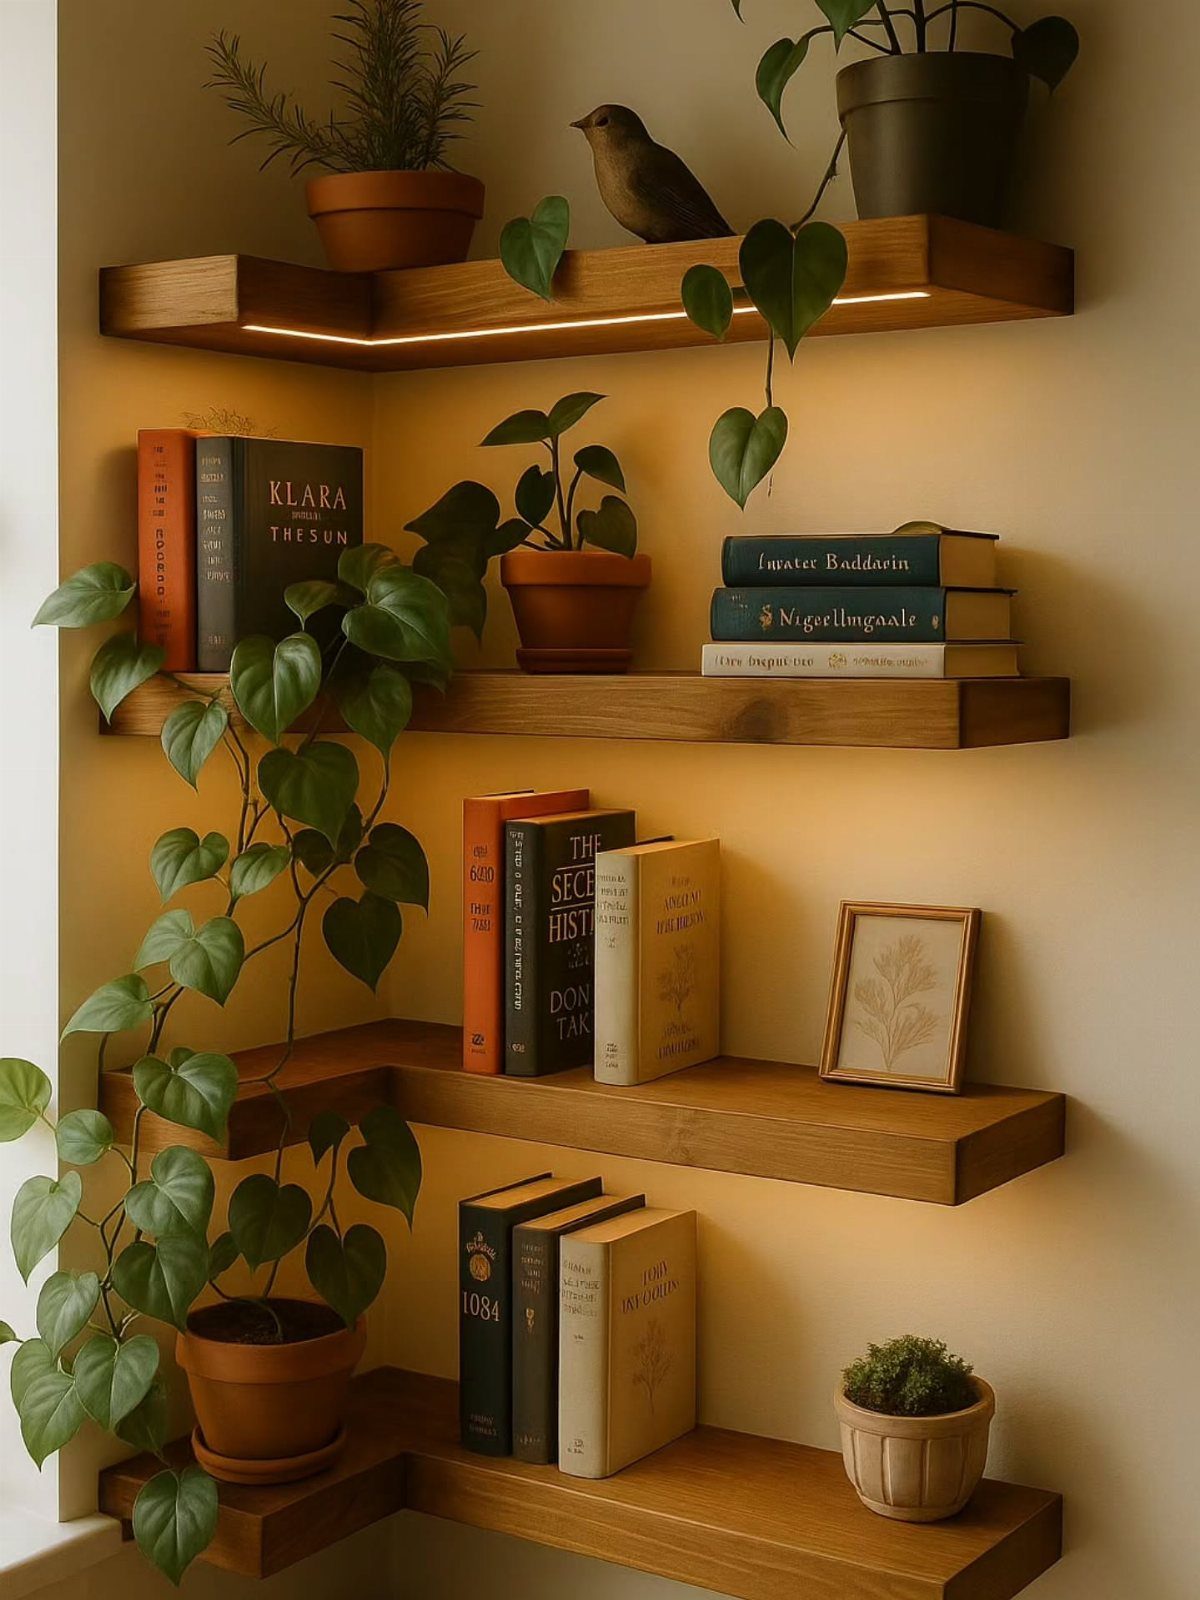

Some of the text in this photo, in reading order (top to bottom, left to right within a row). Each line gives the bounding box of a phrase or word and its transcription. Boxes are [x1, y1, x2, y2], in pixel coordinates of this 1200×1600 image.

[269, 480, 347, 511] KLARA
[569, 833, 602, 860] THE
[550, 983, 590, 1014] DON
[556, 1012, 591, 1041] TAK
[462, 1291, 500, 1322] 1084
